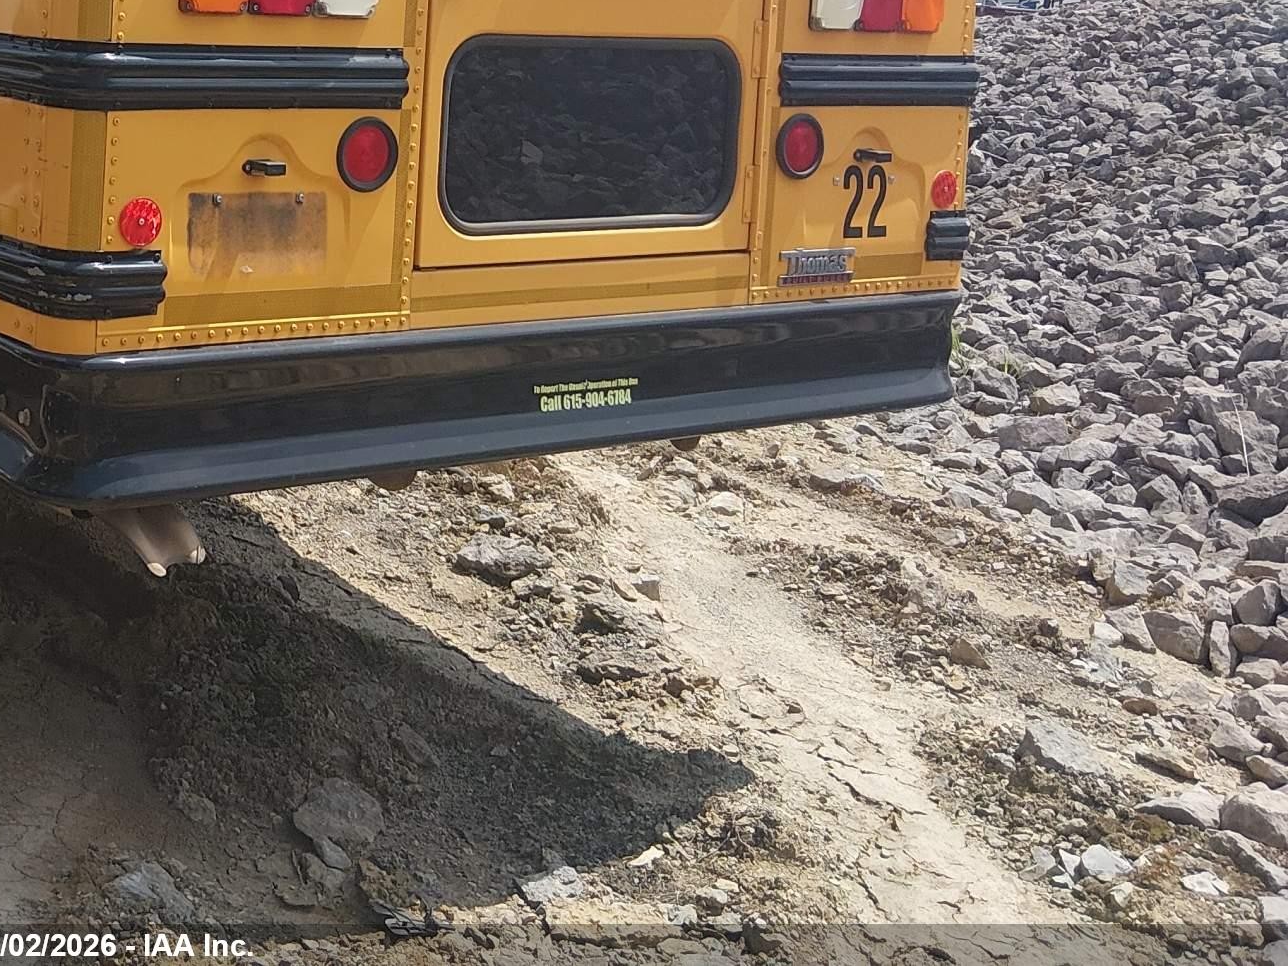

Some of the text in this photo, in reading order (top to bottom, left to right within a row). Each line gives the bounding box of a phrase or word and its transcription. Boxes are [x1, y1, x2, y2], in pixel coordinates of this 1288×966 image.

[843, 164, 887, 239] 22
[778, 248, 856, 277] Thomas
[540, 394, 562, 412] Call
